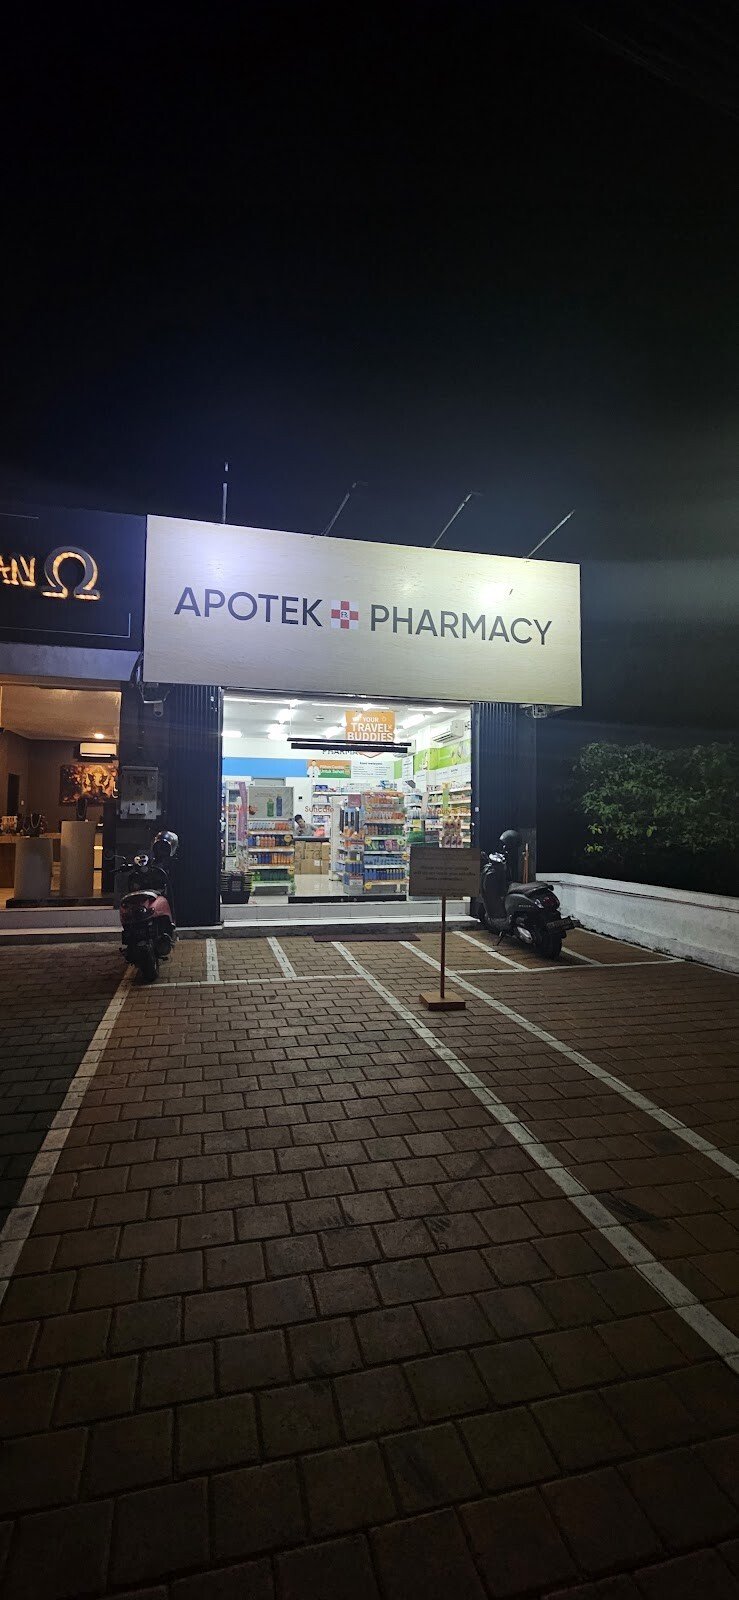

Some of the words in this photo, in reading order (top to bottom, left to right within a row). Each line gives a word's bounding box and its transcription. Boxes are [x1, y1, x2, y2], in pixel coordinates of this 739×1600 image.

[174, 586, 323, 627] APOTEK
[370, 604, 552, 645] PHARMACY
[350, 723, 390, 732] TRAVEL
[347, 732, 394, 741] BUDDIES
